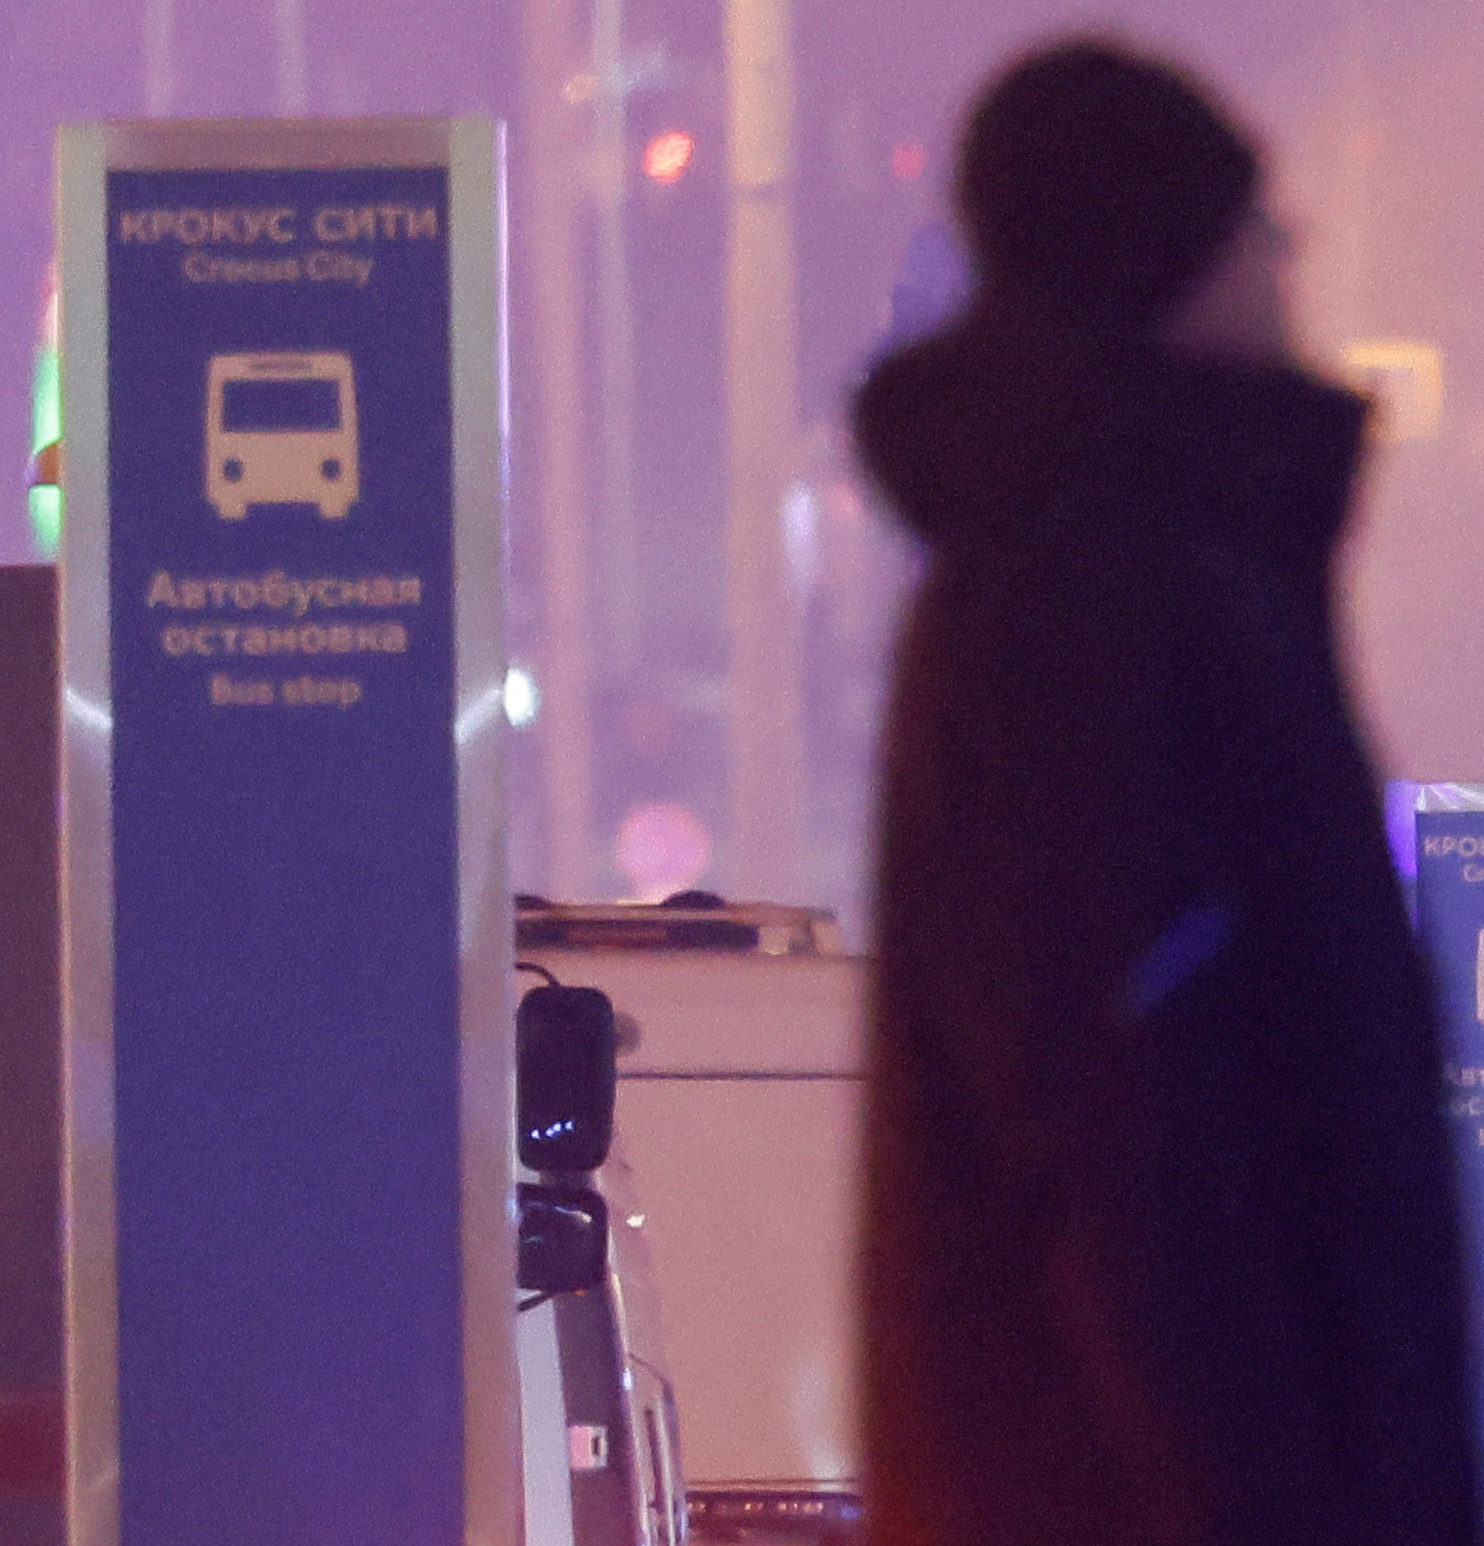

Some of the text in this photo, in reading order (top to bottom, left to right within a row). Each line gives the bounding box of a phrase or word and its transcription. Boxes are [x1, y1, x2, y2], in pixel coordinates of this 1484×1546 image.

[119, 206, 438, 243] КРОКУС СИТИ
[183, 252, 374, 287] Crocus City
[148, 569, 421, 615] Автобусная
[161, 624, 408, 655] остановка
[211, 672, 361, 709] Bus stop
